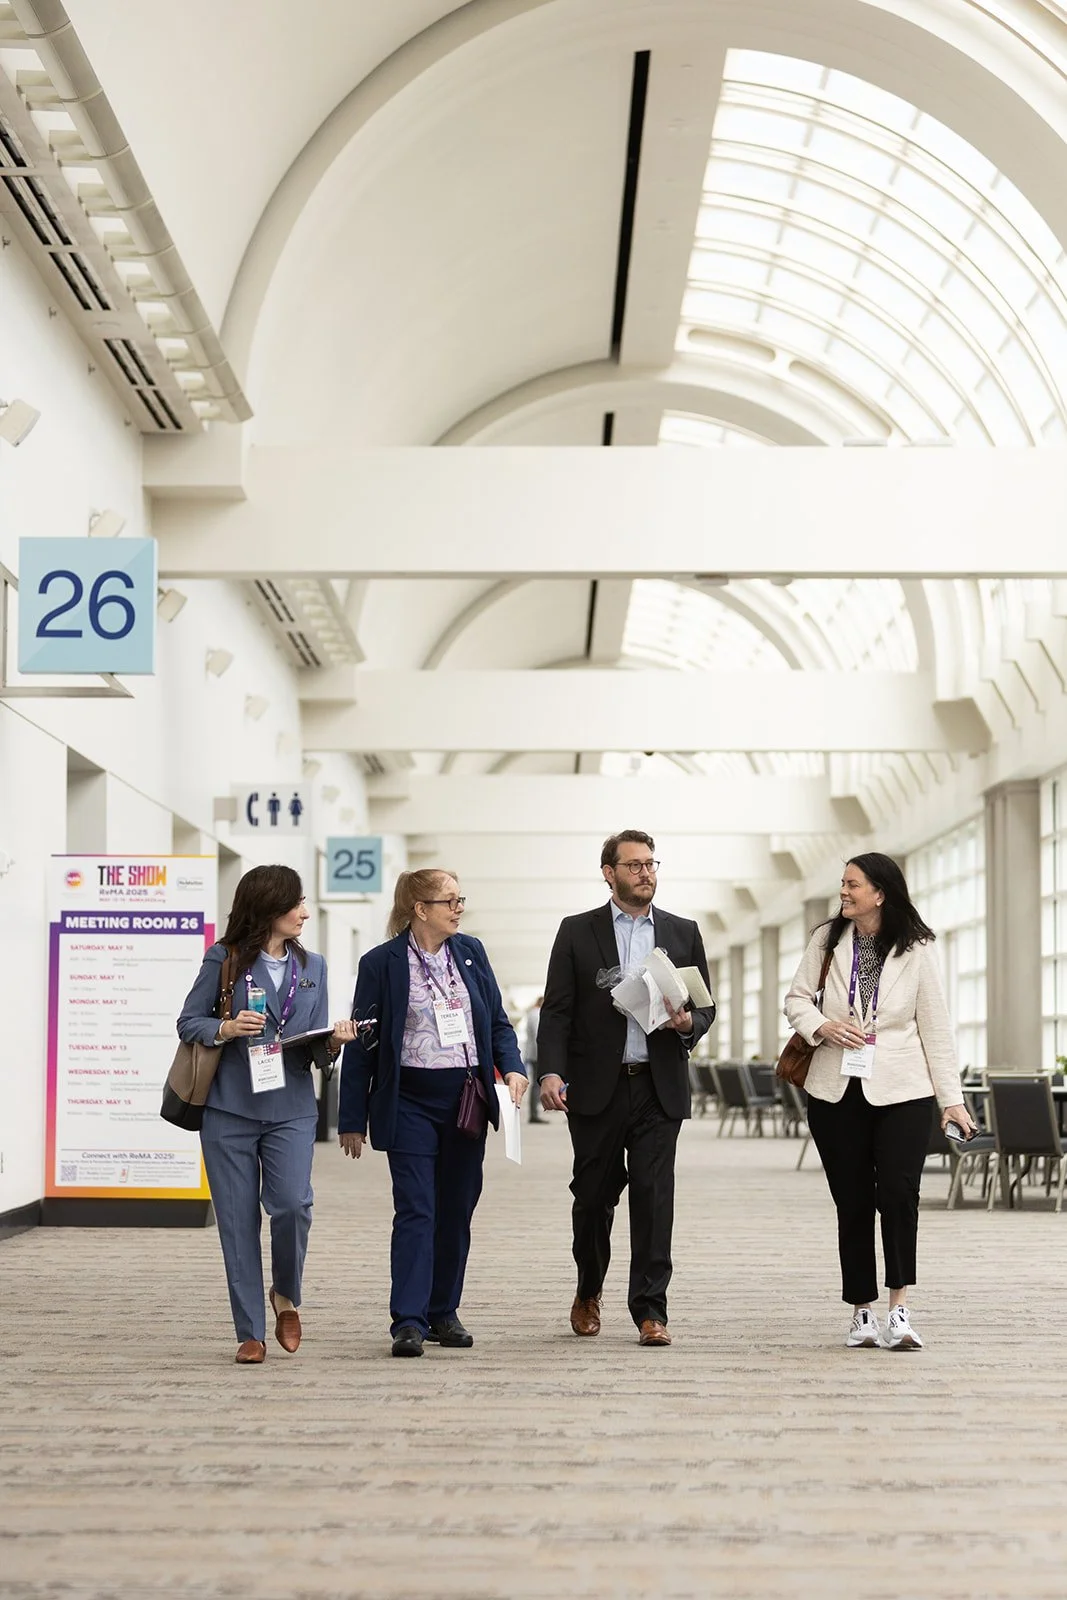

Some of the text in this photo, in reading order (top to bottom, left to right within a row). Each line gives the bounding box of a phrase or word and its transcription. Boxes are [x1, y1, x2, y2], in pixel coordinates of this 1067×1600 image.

[36, 570, 136, 640] 26
[98, 865, 124, 886] THE
[128, 865, 167, 886] SHOW
[332, 850, 376, 880] 25
[66, 917, 198, 930] MEETING ROOM 26
